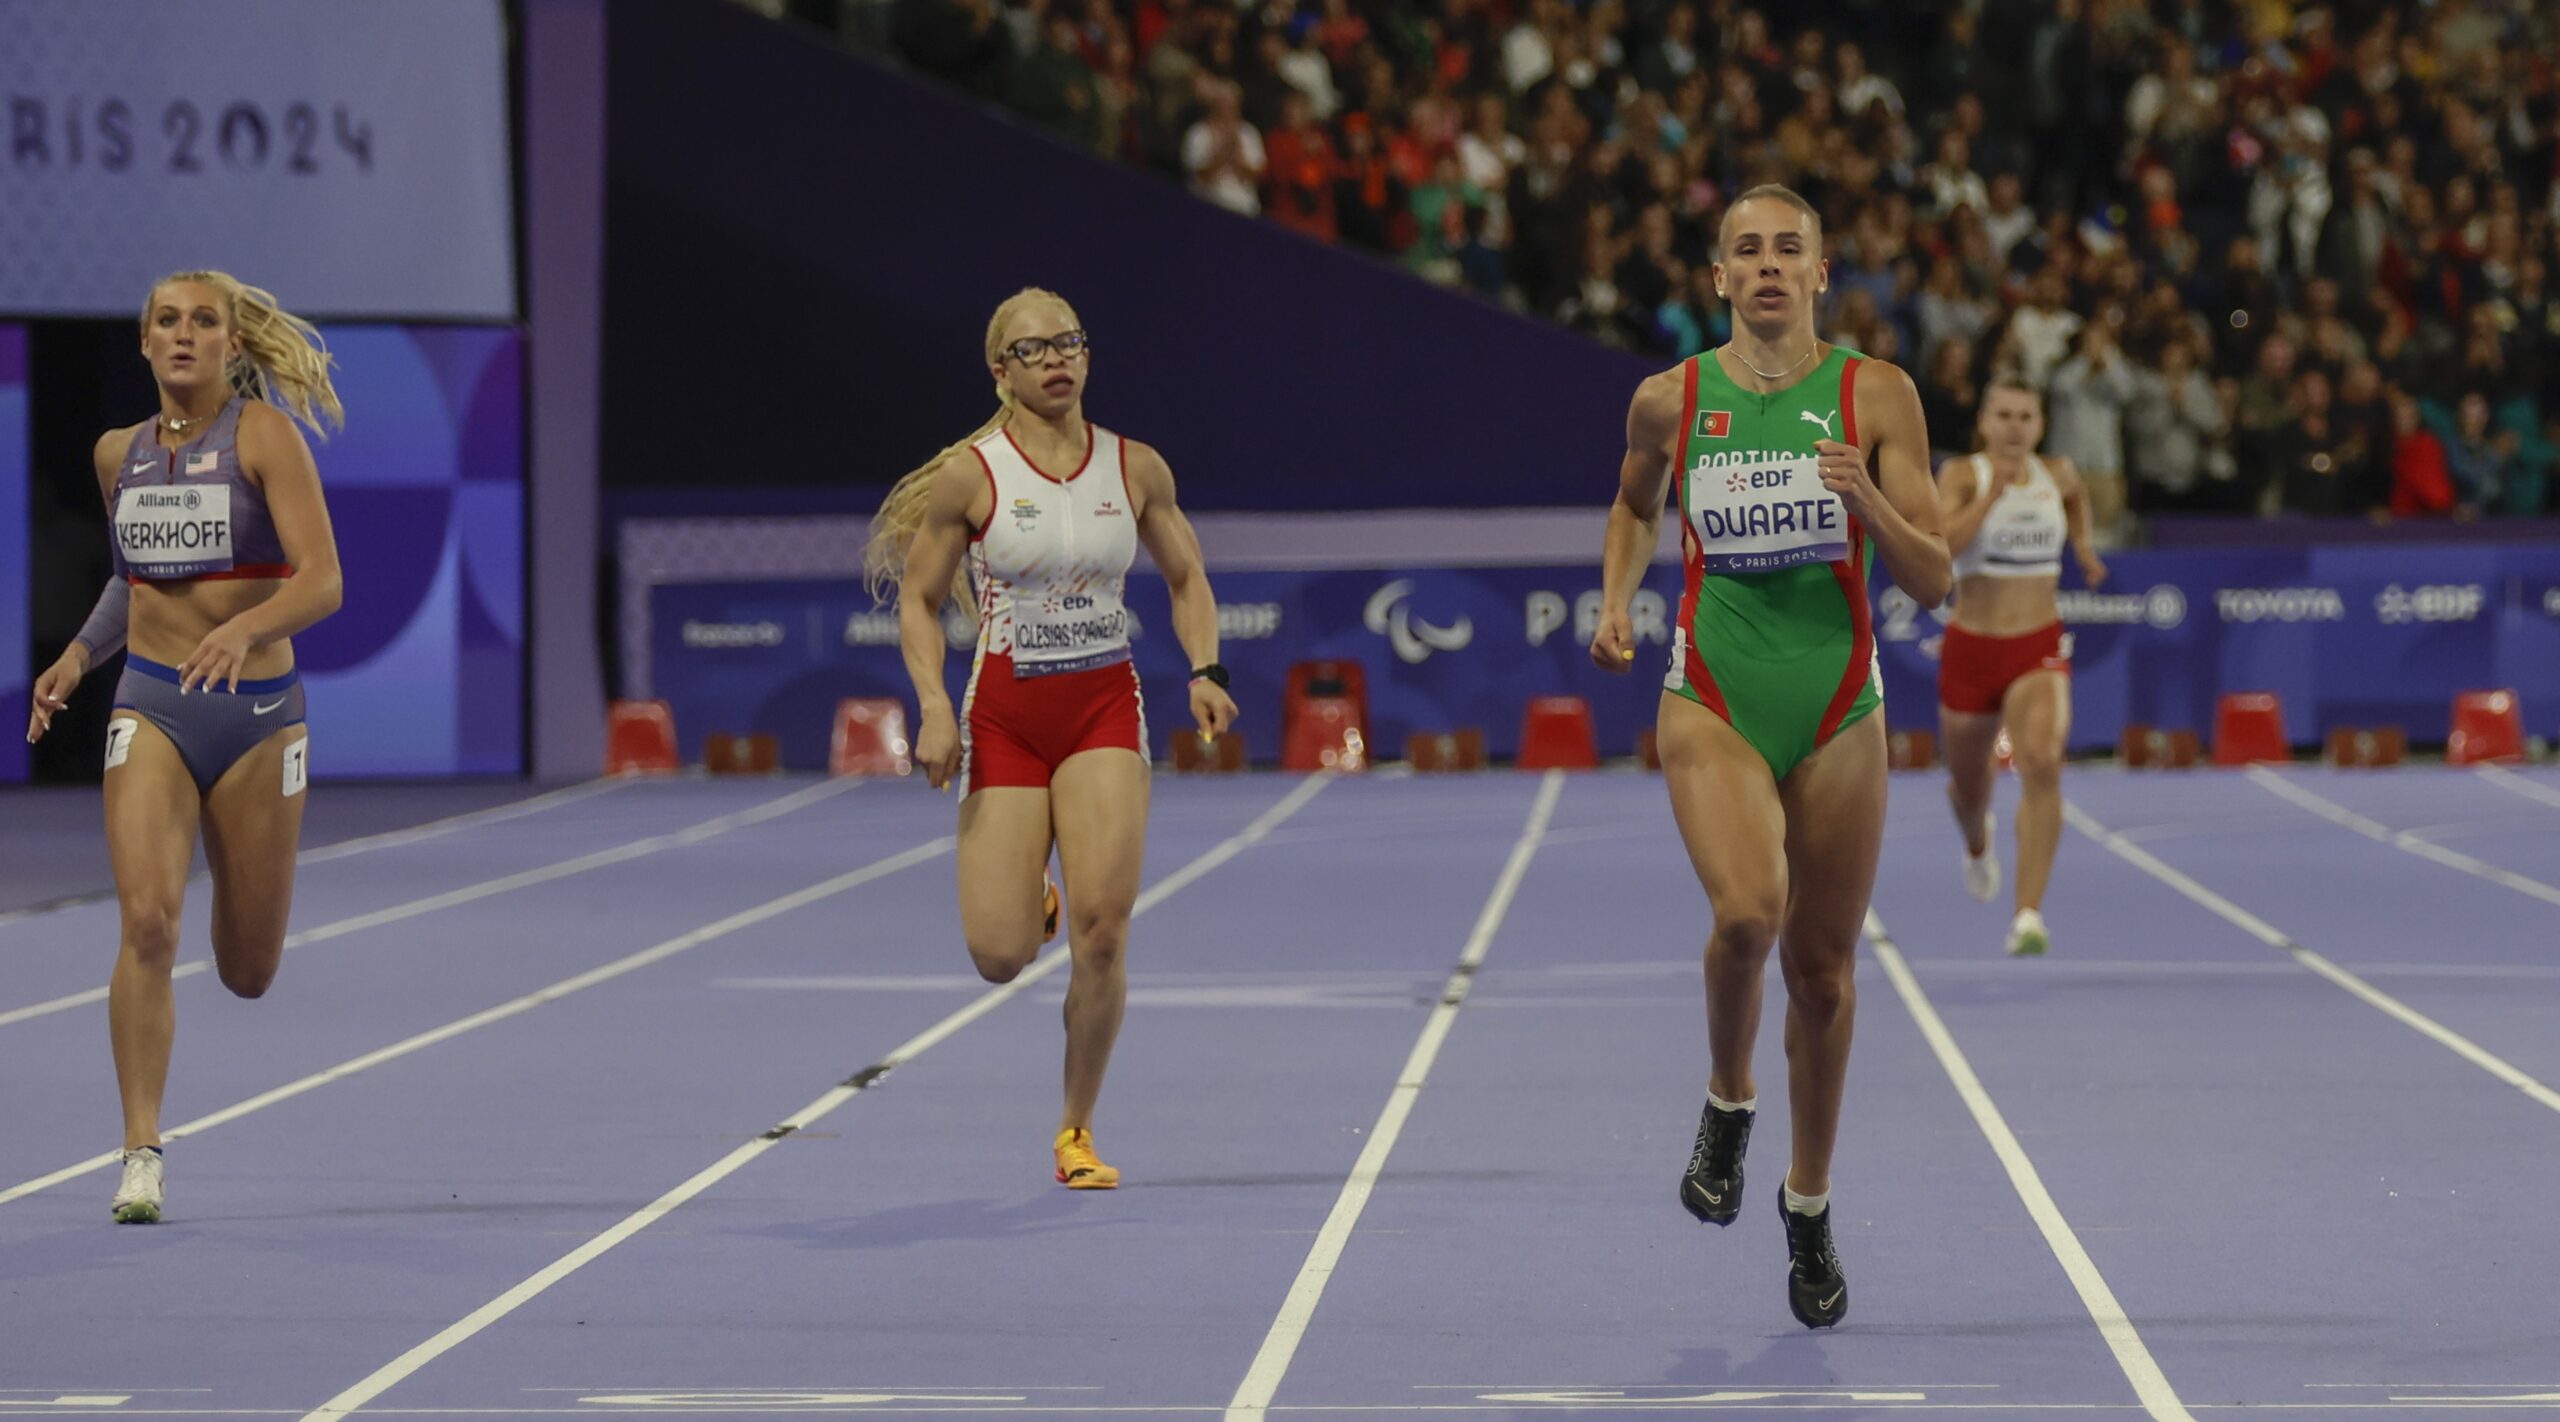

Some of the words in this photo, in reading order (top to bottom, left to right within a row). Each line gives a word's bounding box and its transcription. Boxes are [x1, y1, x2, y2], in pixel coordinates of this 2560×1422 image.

[161, 99, 375, 174] 2024
[1751, 469, 1793, 489] eDF
[136, 493, 182, 507] Allianz
[1703, 499, 1837, 539] DUARTE
[119, 520, 226, 549] KERKHOFF
[1746, 557, 1780, 568] PARIS
[1525, 589, 1669, 648] PAR
